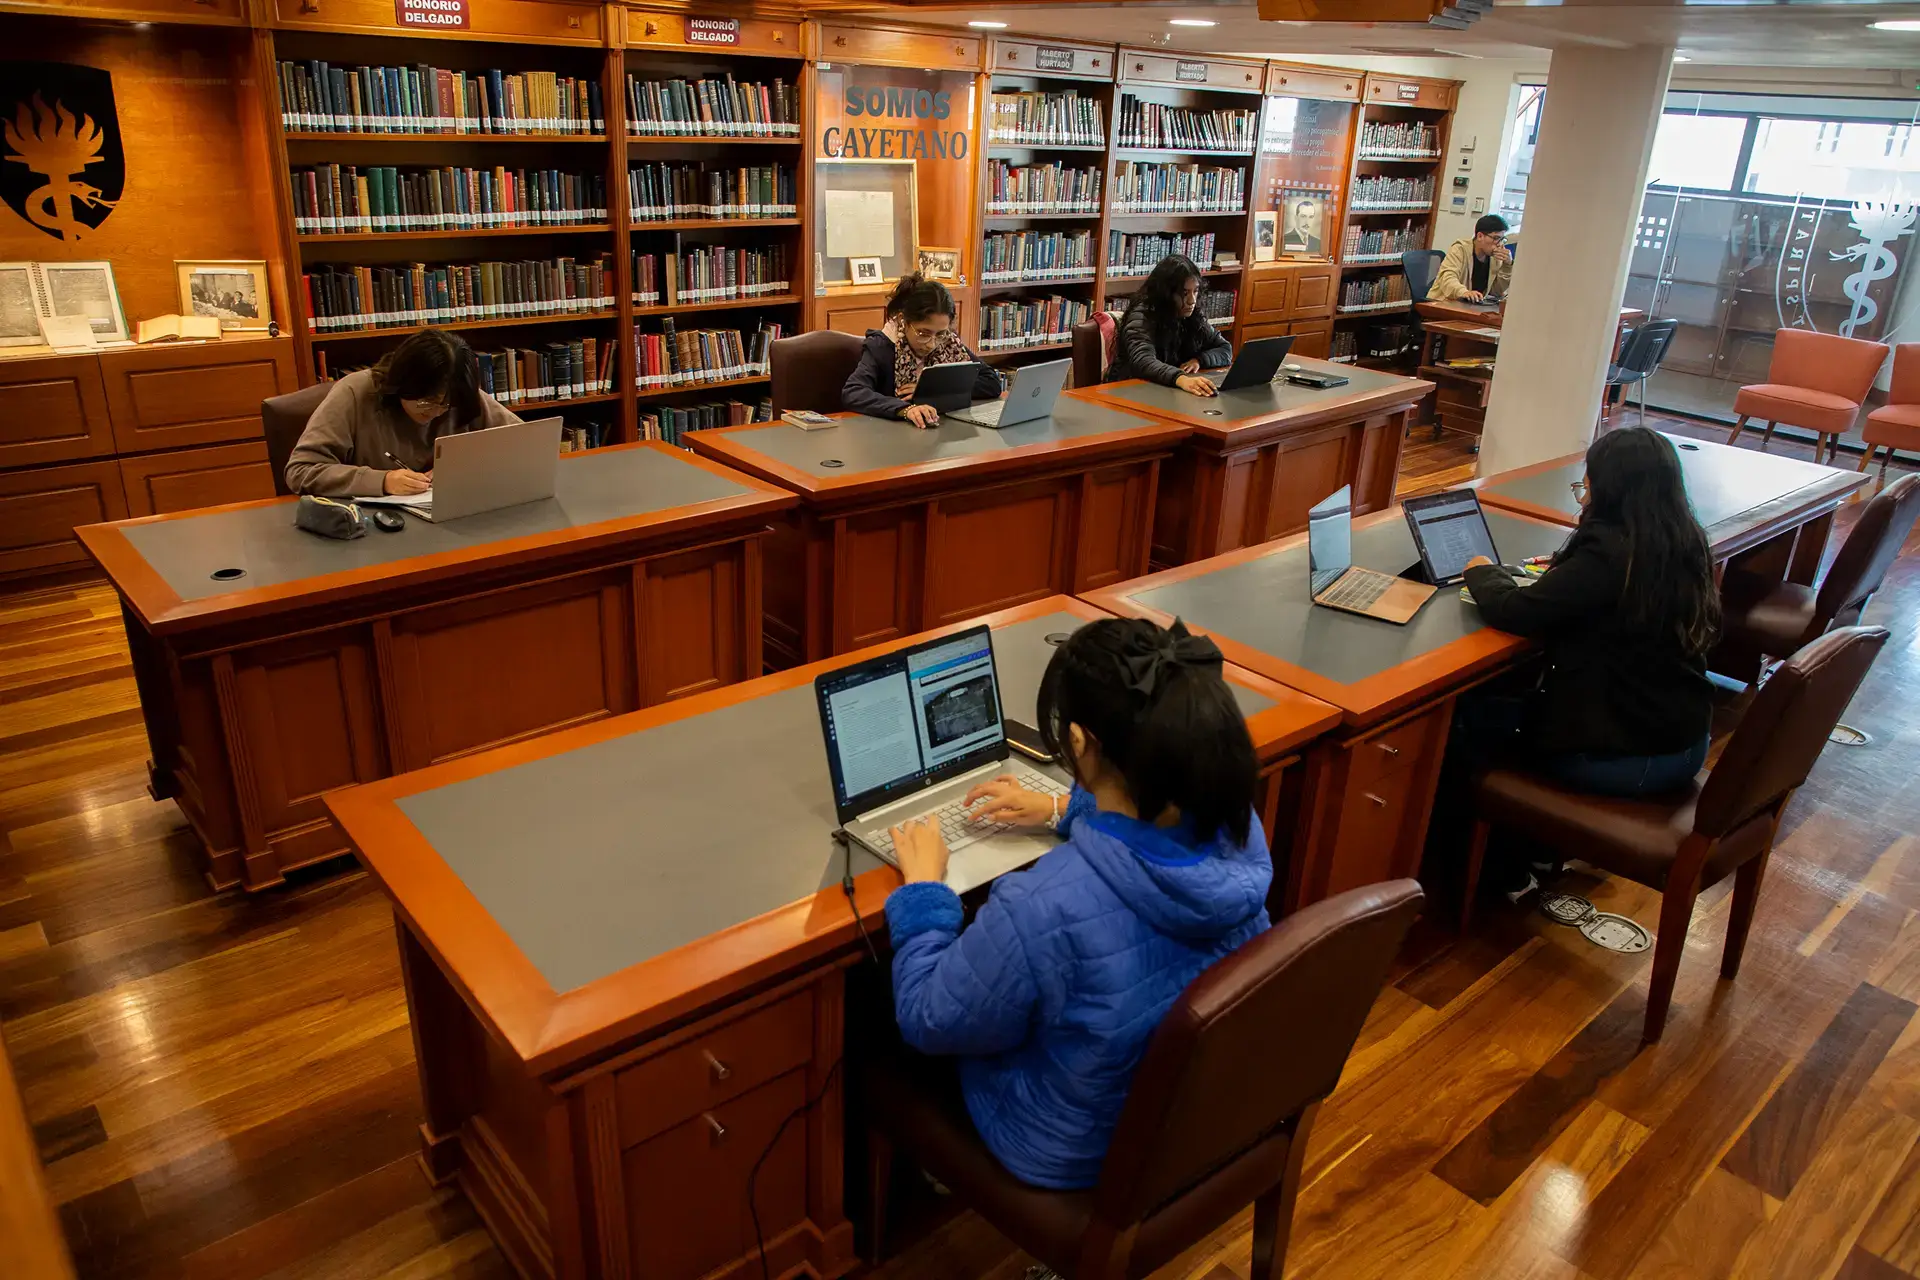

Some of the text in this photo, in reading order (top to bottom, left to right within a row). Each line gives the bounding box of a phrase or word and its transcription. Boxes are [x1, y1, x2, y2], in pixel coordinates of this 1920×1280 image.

[404, 0, 461, 11] HONORIO
[405, 12, 462, 25] DELGADO
[691, 19, 735, 31] HONORIO
[691, 31, 735, 43] DELGADO
[1041, 50, 1070, 59] ALBERTO
[1040, 60, 1070, 69] HURTADO
[845, 85, 951, 120] SOMOS
[823, 127, 968, 160] CAYETANO
